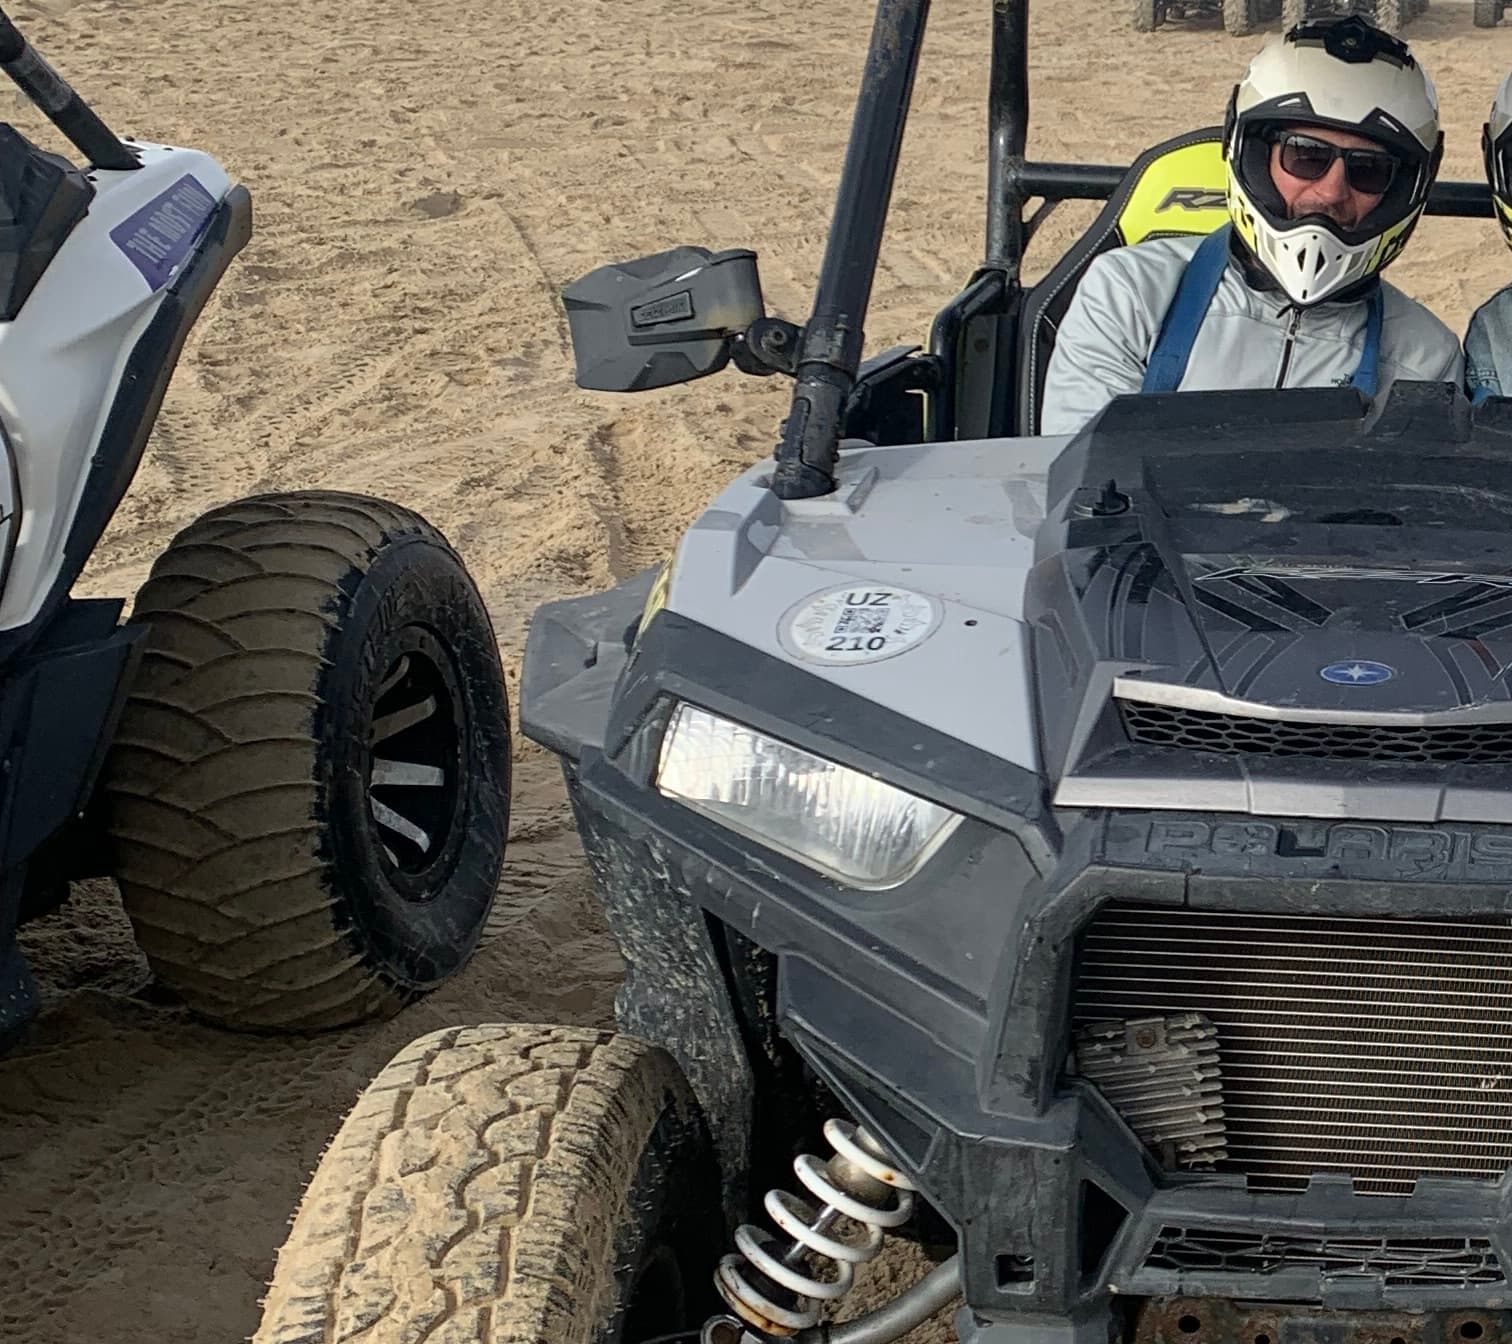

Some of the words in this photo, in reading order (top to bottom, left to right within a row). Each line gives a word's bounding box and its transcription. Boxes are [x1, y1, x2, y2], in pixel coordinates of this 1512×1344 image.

[125, 227, 171, 264] THE
[148, 201, 195, 243] MOST
[845, 591, 894, 606] UZ
[825, 635, 887, 652] 210
